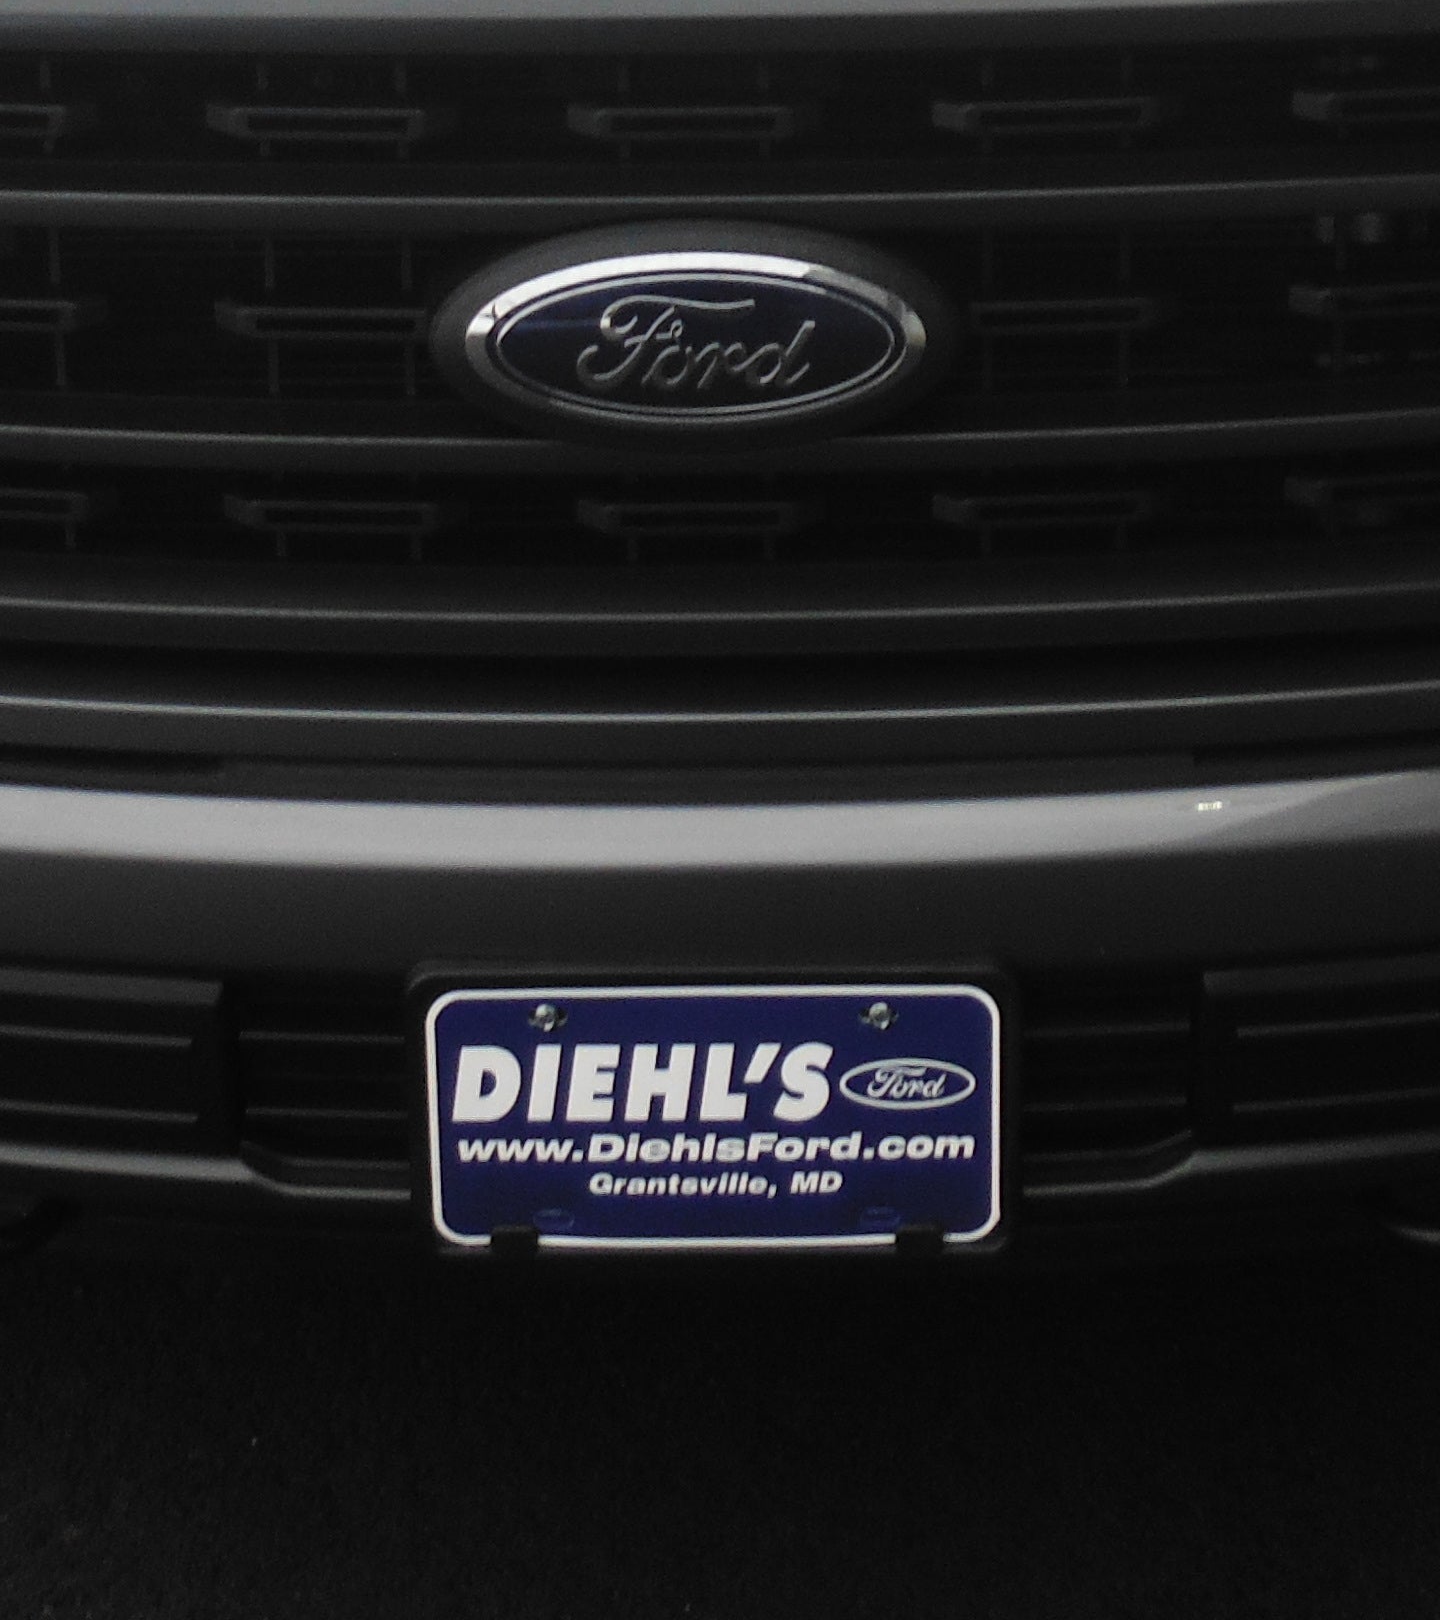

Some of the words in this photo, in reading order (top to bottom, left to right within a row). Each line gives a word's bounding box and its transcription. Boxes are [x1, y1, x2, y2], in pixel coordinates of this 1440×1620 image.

[576, 294, 817, 390] Ford
[452, 1042, 833, 1122] DIEHL'S
[866, 1065, 948, 1101] Ford
[458, 1131, 975, 1163] www.DiehlsFord.com
[589, 1172, 777, 1199] Grantsville,
[790, 1171, 843, 1194] MD
